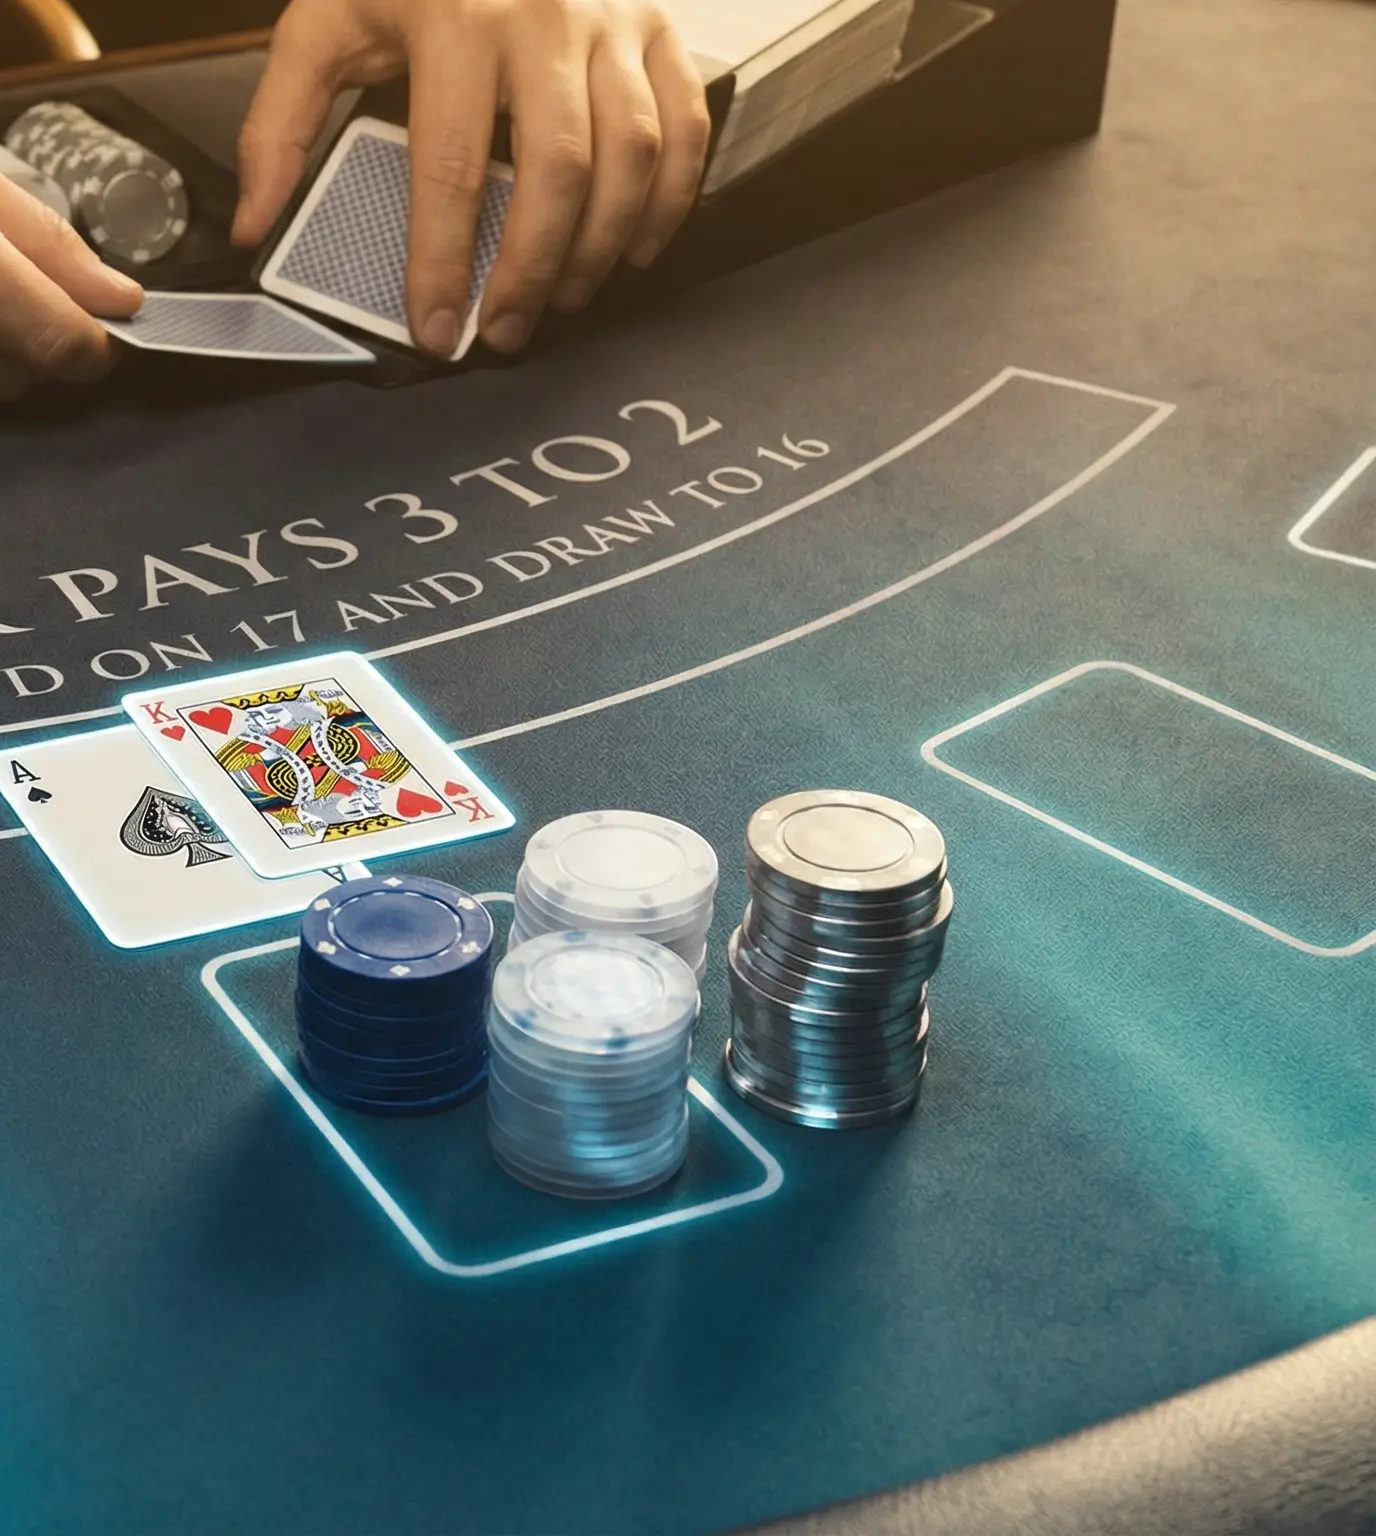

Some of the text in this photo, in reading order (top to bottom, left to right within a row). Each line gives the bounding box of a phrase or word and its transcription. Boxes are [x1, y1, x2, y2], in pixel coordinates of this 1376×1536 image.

[38, 517, 360, 623] PAYS
[364, 492, 460, 544] 3
[449, 435, 632, 508] TO
[618, 399, 724, 447] 2
[90, 633, 214, 681] ON
[229, 609, 307, 652] 17
[336, 571, 485, 632] AND
[486, 499, 677, 583] DRAW
[668, 466, 764, 509] TO
[757, 433, 831, 471] 16
[139, 700, 178, 724] K
[10, 759, 42, 784] A
[452, 796, 495, 822] K
